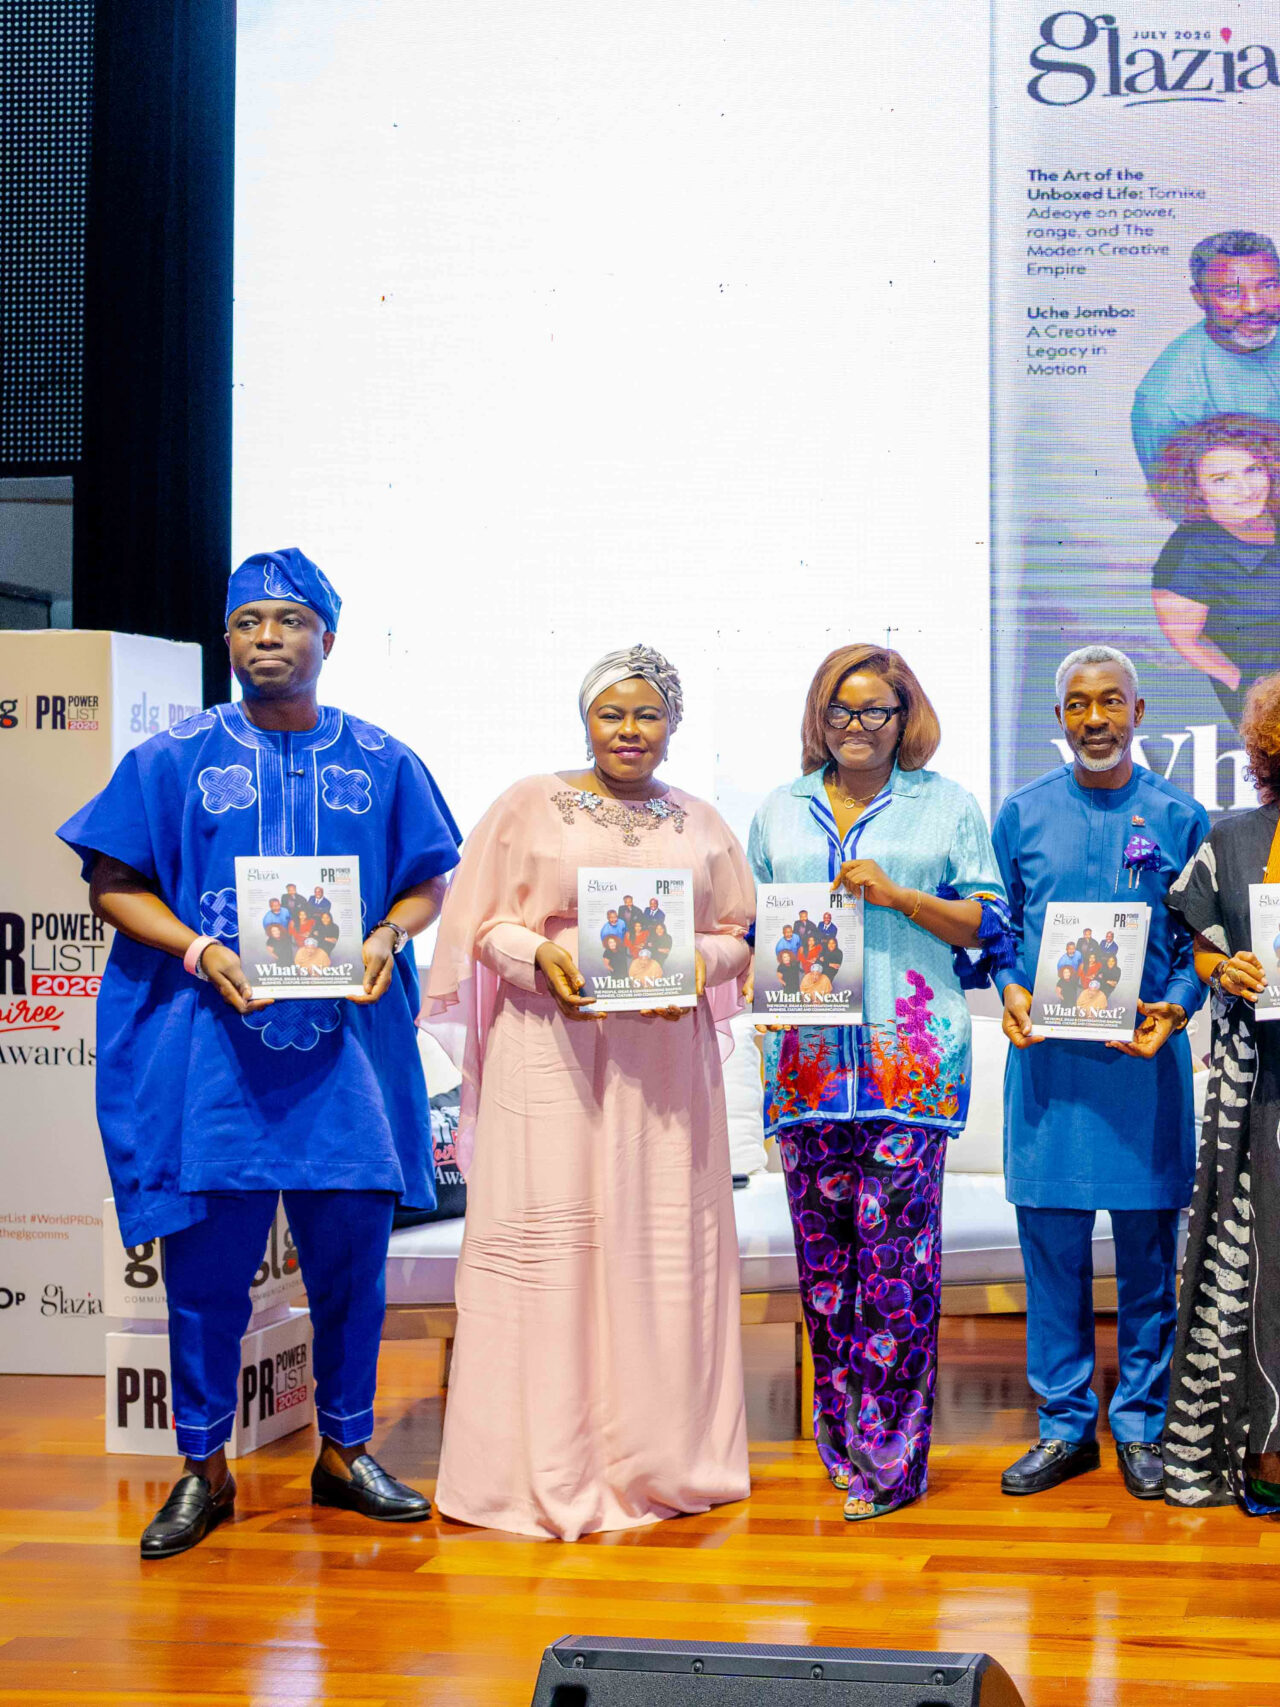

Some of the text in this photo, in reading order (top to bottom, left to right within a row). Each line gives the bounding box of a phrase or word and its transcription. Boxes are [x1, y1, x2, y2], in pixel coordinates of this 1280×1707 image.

[1132, 30, 1212, 39] JULY 2026
[1027, 168, 1145, 181] The Art of the
[1027, 187, 1103, 200] Unboxed
[1108, 187, 1144, 200] Life:
[1096, 209, 1118, 218] on
[1123, 208, 1176, 220] power,
[1027, 223, 1155, 239] range, and The
[1027, 243, 1169, 257] Modern Creative
[1027, 262, 1087, 277] Empire
[1027, 305, 1136, 319] Uche Jombo:
[1026, 324, 1118, 338] A Creative
[1027, 345, 1107, 360] Legacy in
[1027, 363, 1087, 375] Motion
[68, 695, 99, 707] POWER
[36, 695, 67, 730] PR
[68, 708, 98, 720] LIST
[69, 721, 98, 730] 2026
[321, 868, 335, 882] PR
[656, 880, 670, 894] PR
[830, 894, 842, 908] PR
[32, 913, 104, 941] POWER
[1114, 913, 1126, 928] PR
[0, 912, 26, 995] R
[32, 944, 104, 972] LIST
[255, 963, 353, 976] What's Next?
[36, 976, 101, 995] 2026
[591, 973, 684, 989] What's Next?
[765, 989, 852, 1003] What's Next?
[1043, 1003, 1125, 1019] What's Next?
[40, 1283, 104, 1318] glazia
[276, 1343, 307, 1374] POWER
[276, 1365, 306, 1396] LIST
[117, 1367, 169, 1430] PR
[242, 1357, 275, 1429] PR
[277, 1389, 306, 1411] 2026
